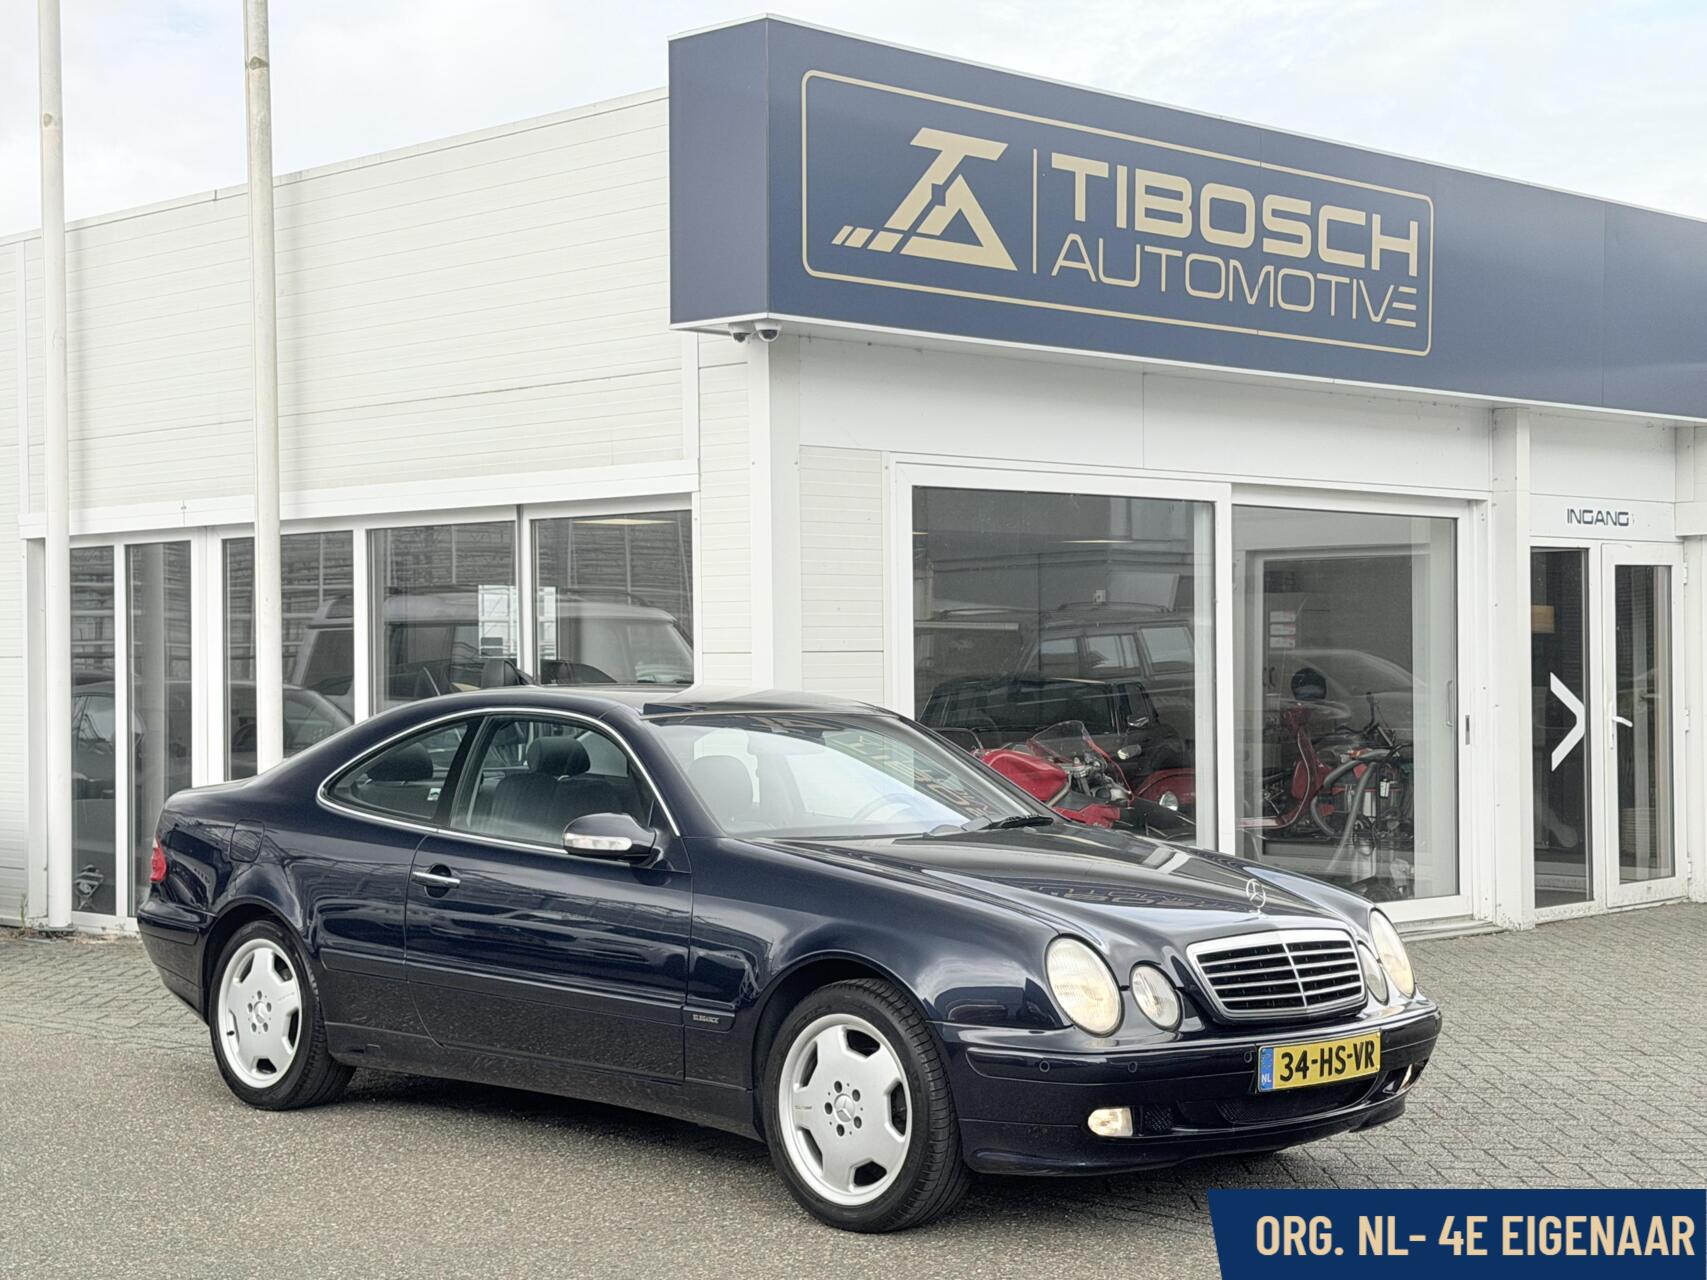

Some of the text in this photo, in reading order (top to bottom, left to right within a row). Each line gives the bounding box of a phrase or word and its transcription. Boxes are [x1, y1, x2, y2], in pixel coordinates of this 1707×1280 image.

[1051, 152, 1419, 277] TIBOSCH
[1051, 233, 1417, 328] AUTOMOTIVE
[1567, 508, 1629, 527] INGANG
[1261, 1072, 1272, 1083] NL
[1280, 1040, 1375, 1082] 34-HS-VR
